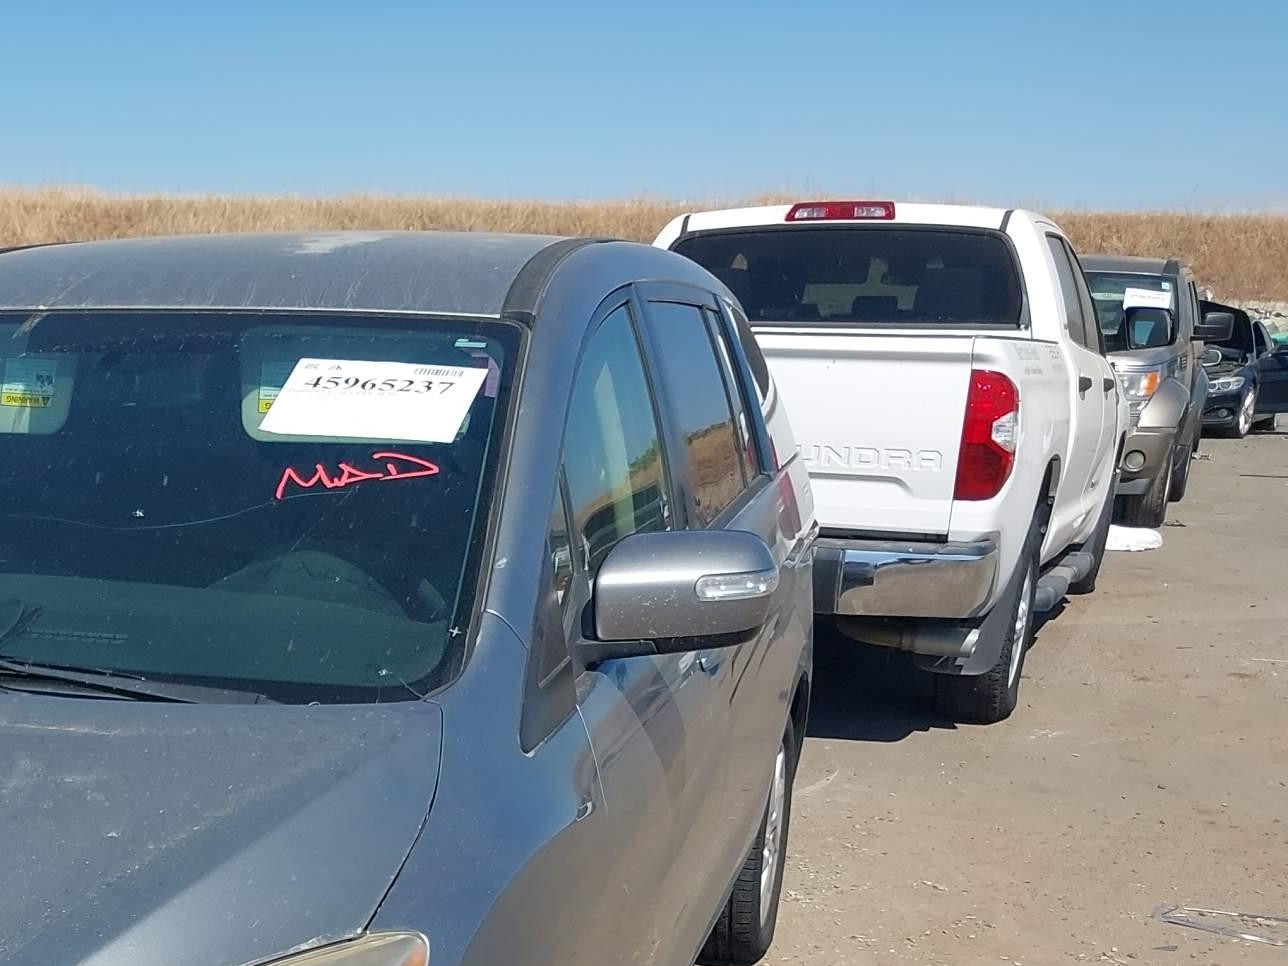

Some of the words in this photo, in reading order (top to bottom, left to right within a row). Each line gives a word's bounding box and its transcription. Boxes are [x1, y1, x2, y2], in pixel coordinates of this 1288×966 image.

[304, 375, 456, 395] 45965237
[795, 443, 944, 473] UNDRA
[275, 451, 441, 501] MAD
